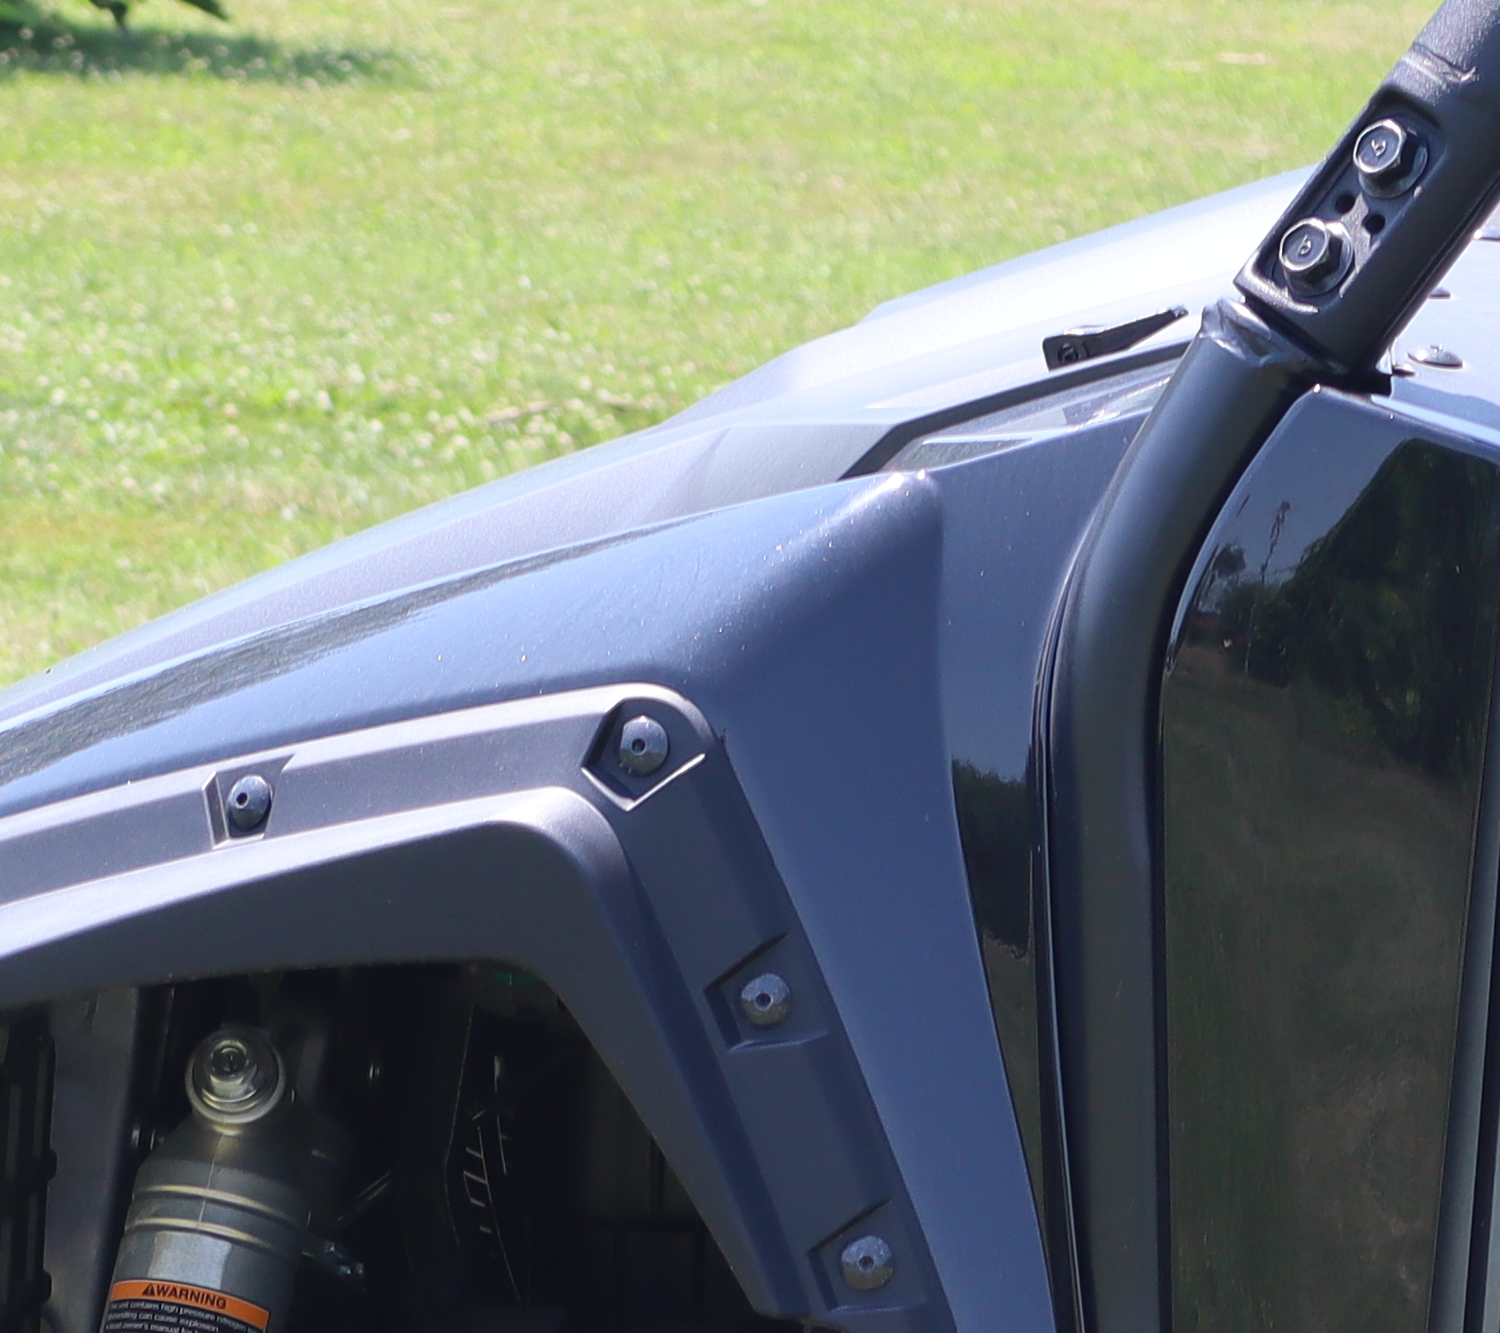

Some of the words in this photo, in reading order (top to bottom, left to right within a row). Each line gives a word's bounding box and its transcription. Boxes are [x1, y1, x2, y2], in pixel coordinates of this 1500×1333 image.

[157, 1284, 226, 1309] WARNING
[154, 1314, 178, 1322] cause
[161, 1303, 178, 1313] high
[179, 1306, 215, 1320] pressure
[150, 1324, 180, 1333] manual
